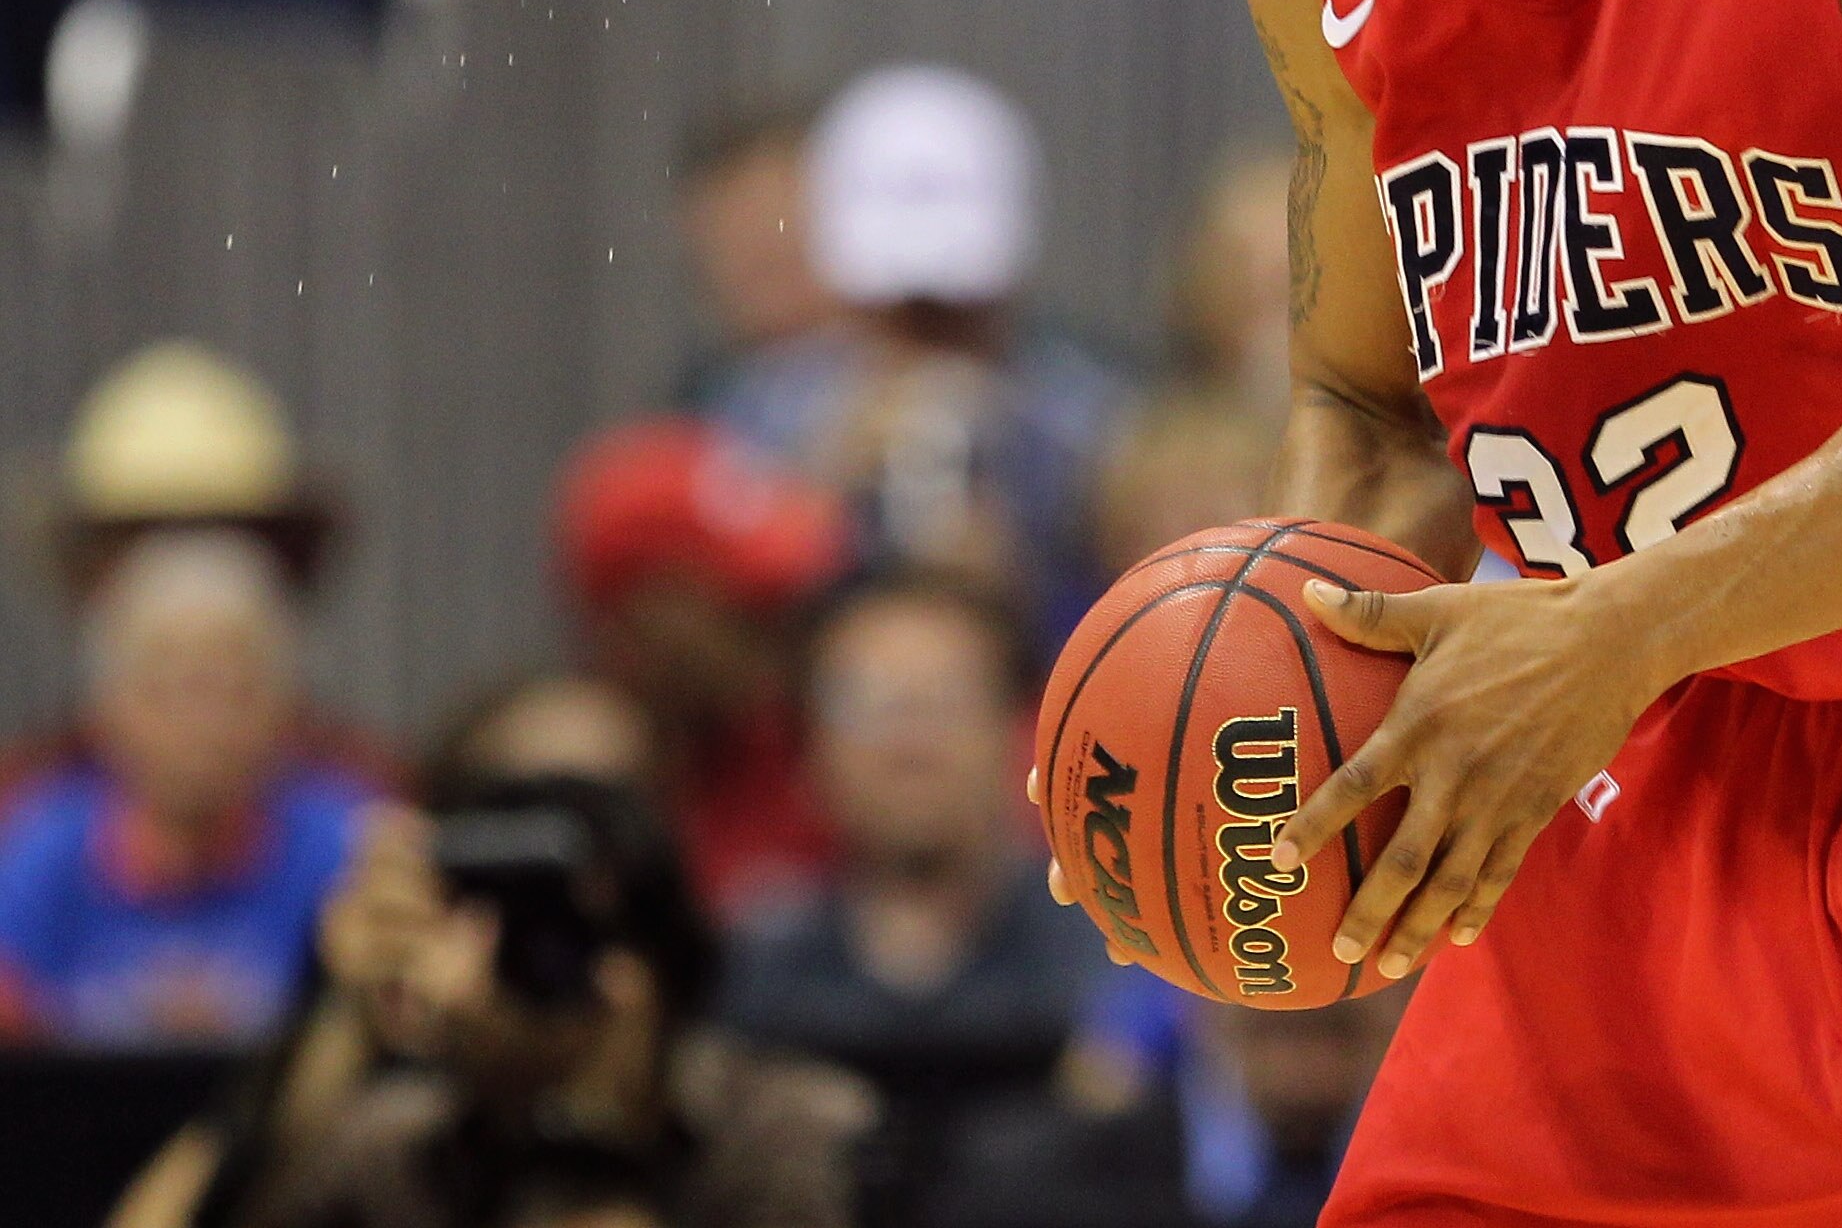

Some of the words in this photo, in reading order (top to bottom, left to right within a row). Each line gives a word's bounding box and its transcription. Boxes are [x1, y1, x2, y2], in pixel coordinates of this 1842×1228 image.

[1465, 372, 1745, 578] 32
[1085, 740, 1159, 956] NCAA
[1212, 706, 1308, 995] Wilson
